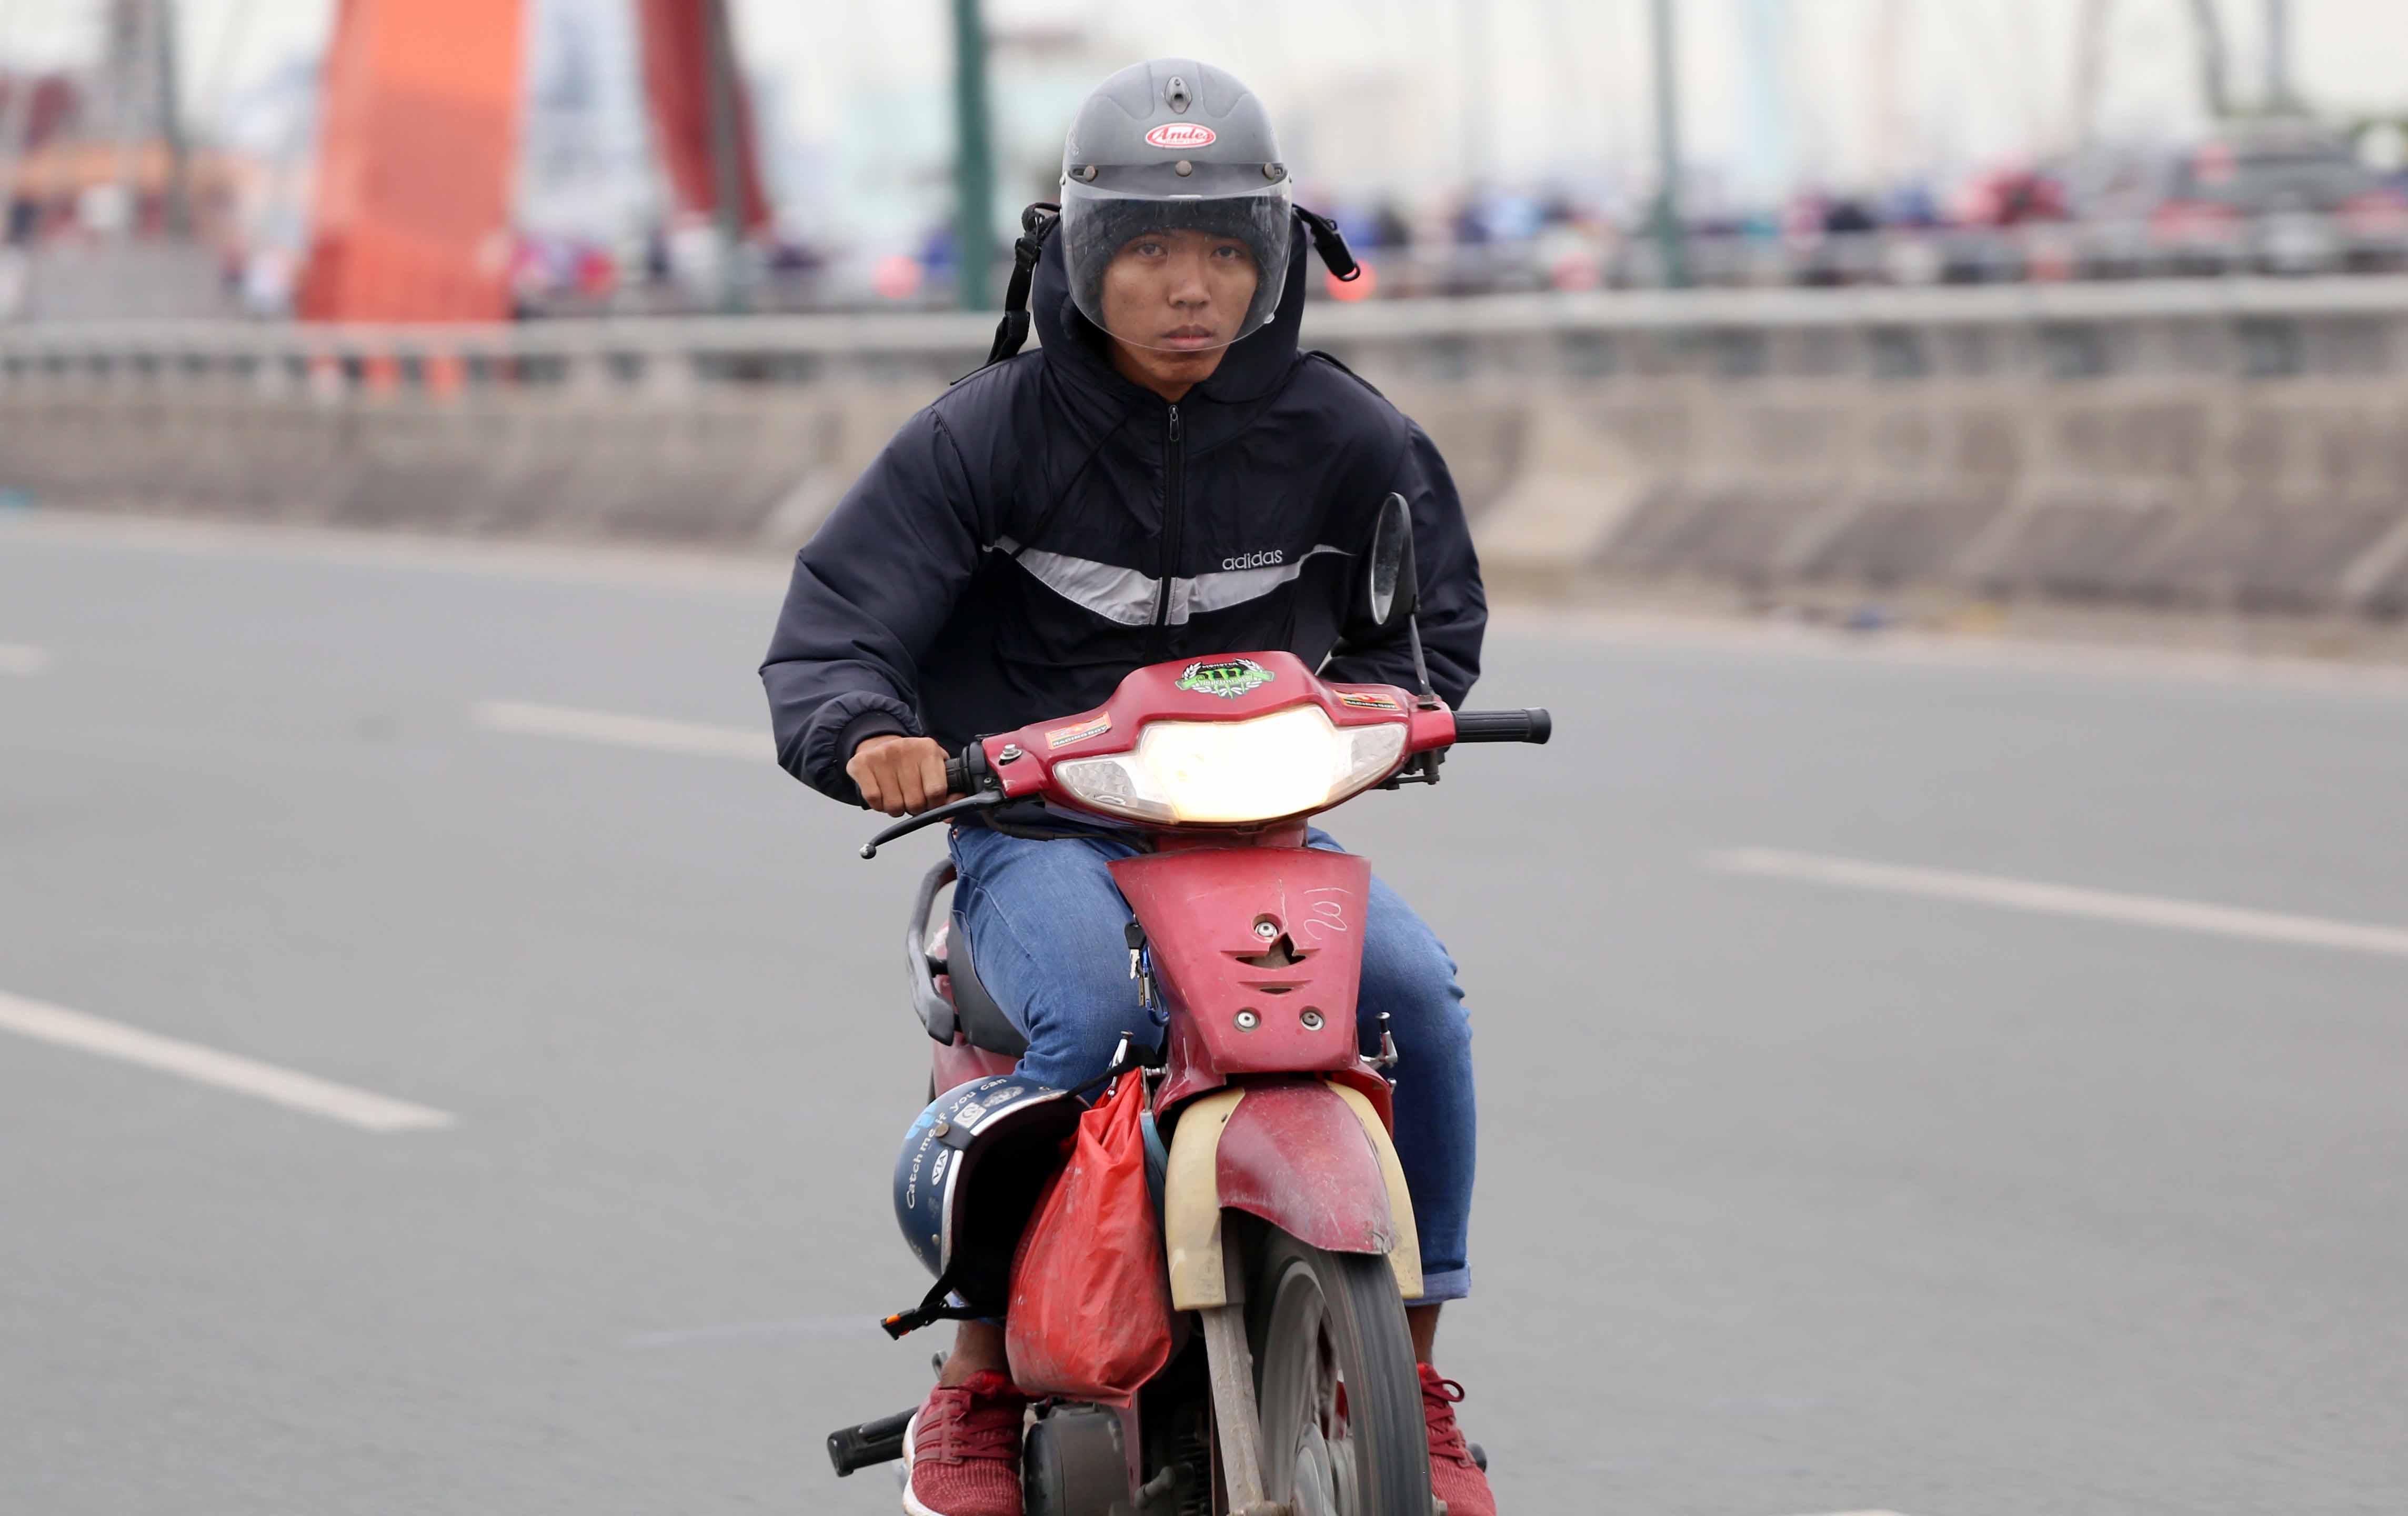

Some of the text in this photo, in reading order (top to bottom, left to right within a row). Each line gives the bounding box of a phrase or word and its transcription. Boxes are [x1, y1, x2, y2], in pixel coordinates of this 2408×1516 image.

[1222, 550, 1283, 570] adidas
[906, 1154, 923, 1209] Catch
[920, 1128, 935, 1152] me
[935, 1112, 947, 1125] if
[949, 1091, 977, 1112] you
[980, 1078, 1007, 1091] can
